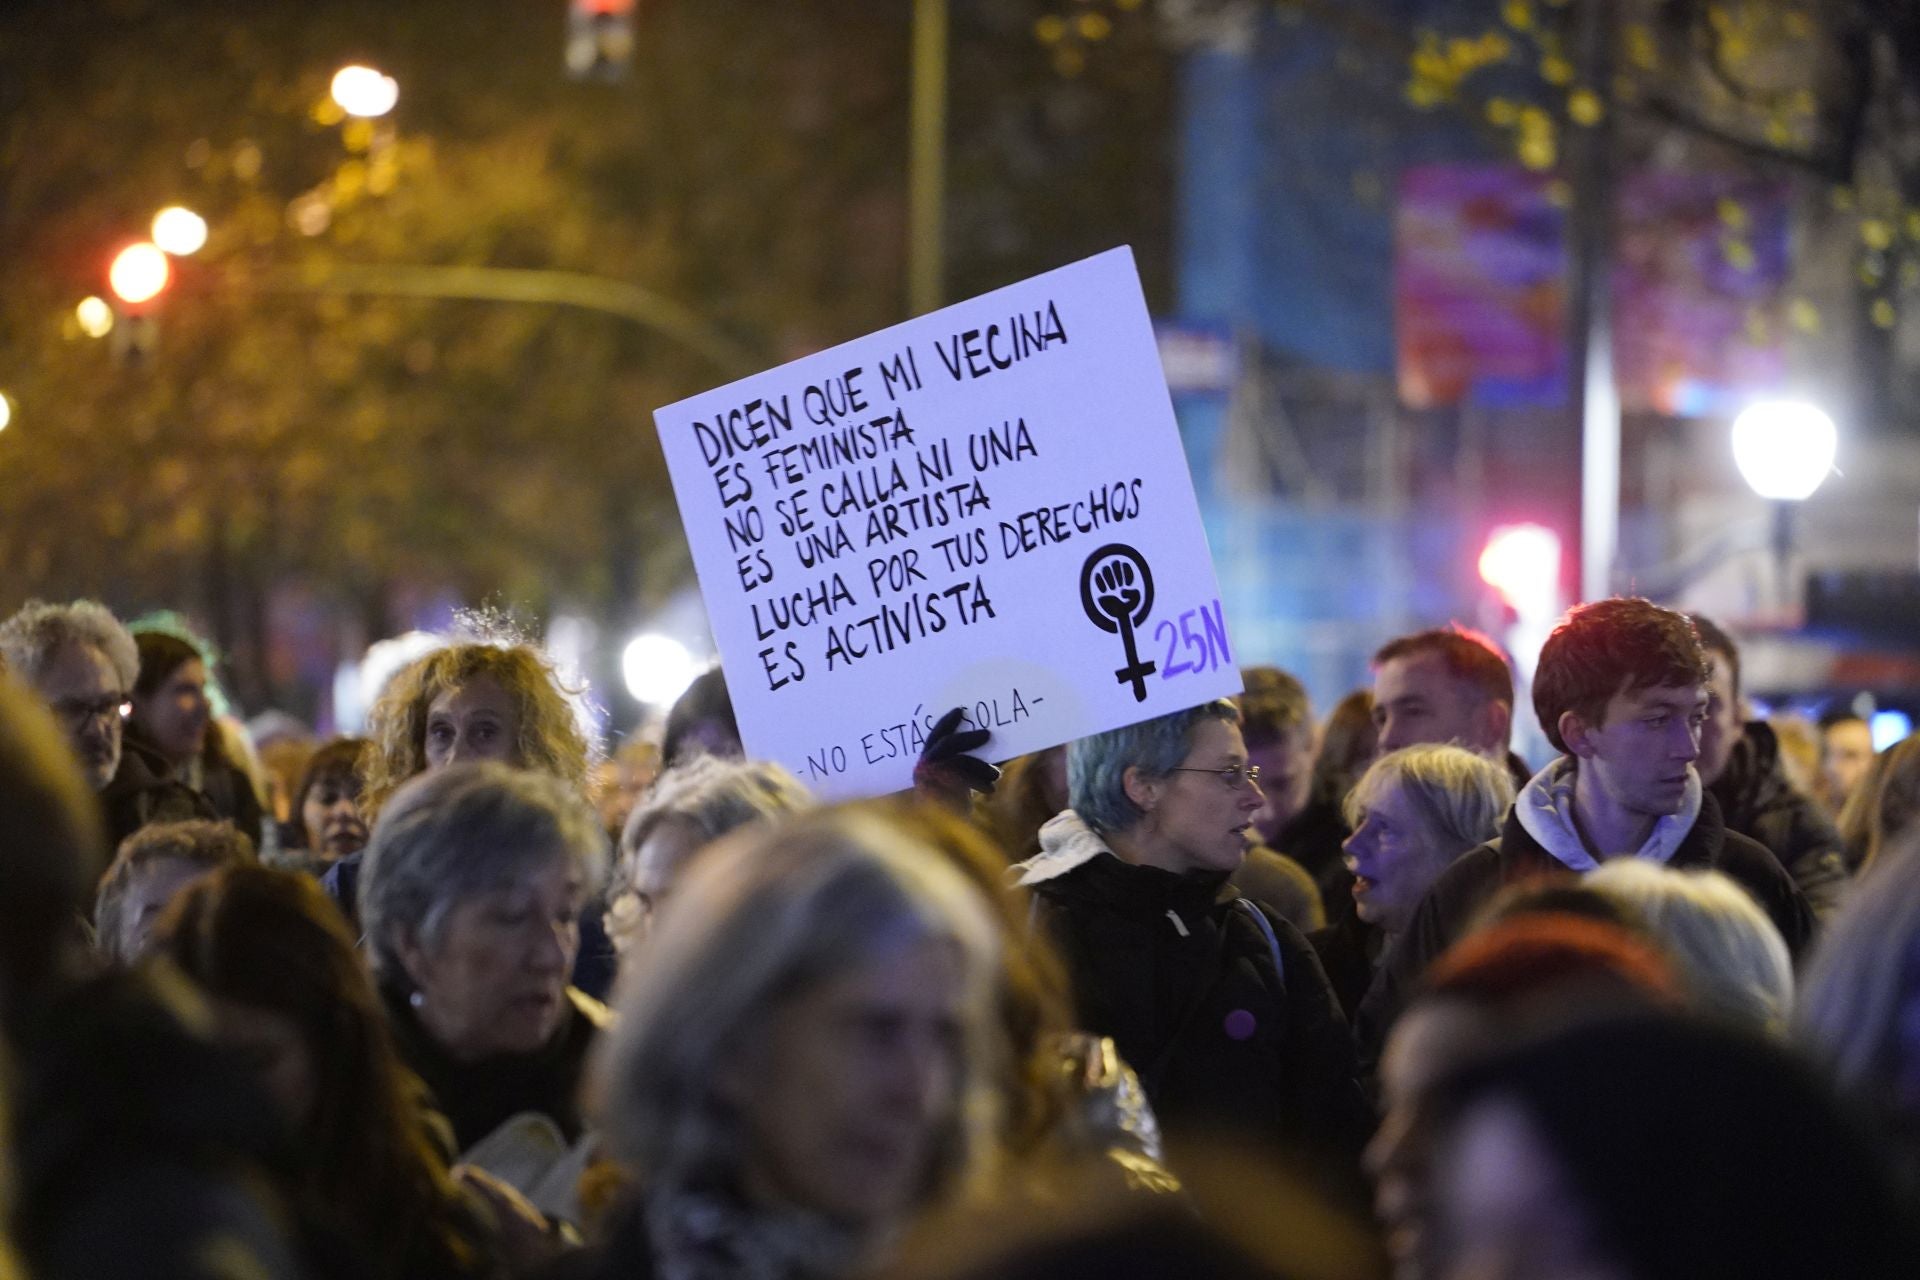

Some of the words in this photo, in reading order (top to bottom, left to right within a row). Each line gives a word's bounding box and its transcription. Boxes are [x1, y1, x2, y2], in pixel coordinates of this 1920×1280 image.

[691, 395, 793, 468] DICEN
[803, 367, 869, 427] QUE
[879, 346, 922, 401] MI
[934, 299, 1068, 381] VECINA
[713, 462, 753, 509] ES
[761, 407, 916, 490] FEMINISTA
[723, 506, 764, 553] NO
[775, 489, 815, 537] SE
[821, 458, 909, 518] CALLA
[916, 438, 954, 488] NI
[968, 417, 1038, 472] UNA
[736, 549, 774, 593] ES
[795, 520, 856, 568] UNA
[866, 476, 991, 548] ARTISTA
[750, 572, 858, 641] LUCHA
[867, 549, 928, 598] POR
[931, 528, 989, 572] TUS
[998, 478, 1142, 560] DERECHOS
[758, 641, 805, 691] ES
[825, 574, 996, 671] ACTIVISTA
[1155, 600, 1230, 680] 25N
